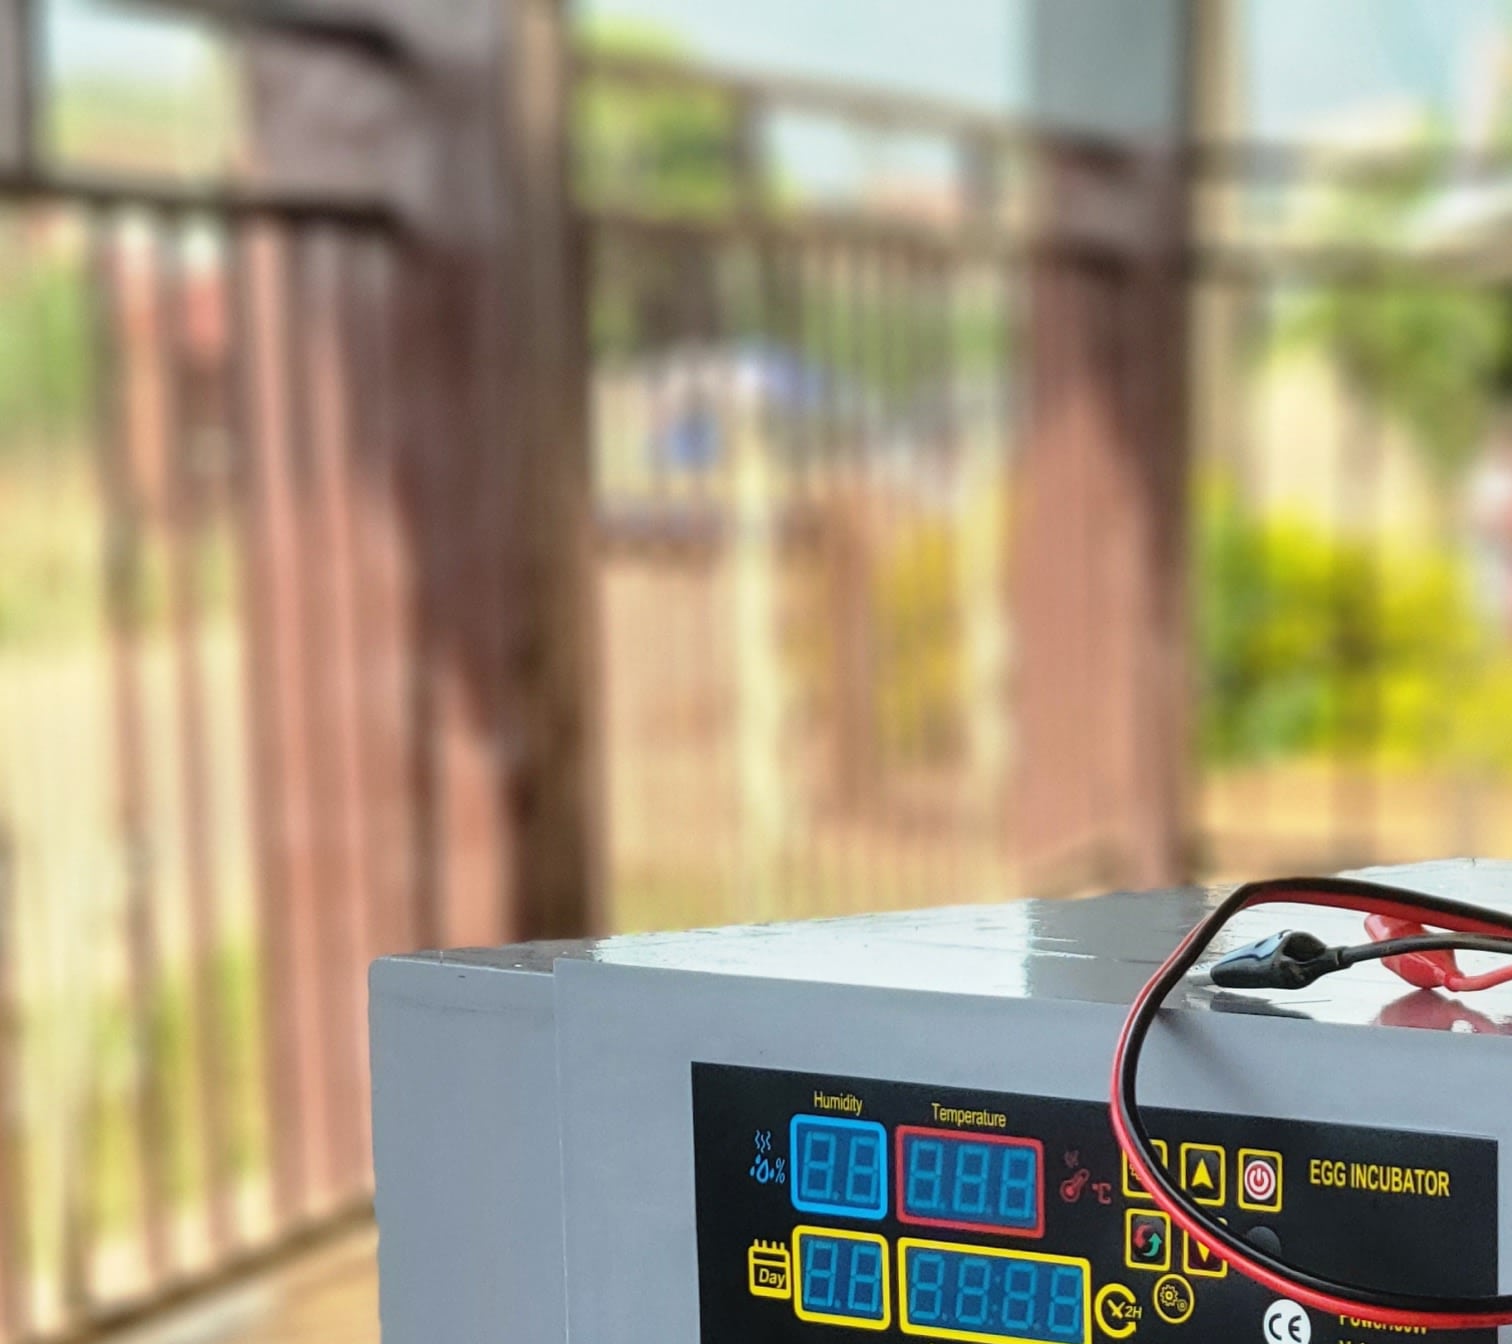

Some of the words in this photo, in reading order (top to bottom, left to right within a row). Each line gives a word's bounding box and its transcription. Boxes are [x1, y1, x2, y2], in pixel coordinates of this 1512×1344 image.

[813, 1090, 863, 1117] Humidity
[931, 1102, 1008, 1128] Temperature
[1309, 1159, 1346, 1187] EGG
[1350, 1163, 1450, 1198] INCUBATOR
[759, 1268, 785, 1289] Day
[1124, 1305, 1143, 1319] 2H
[1268, 1312, 1303, 1344] CE
